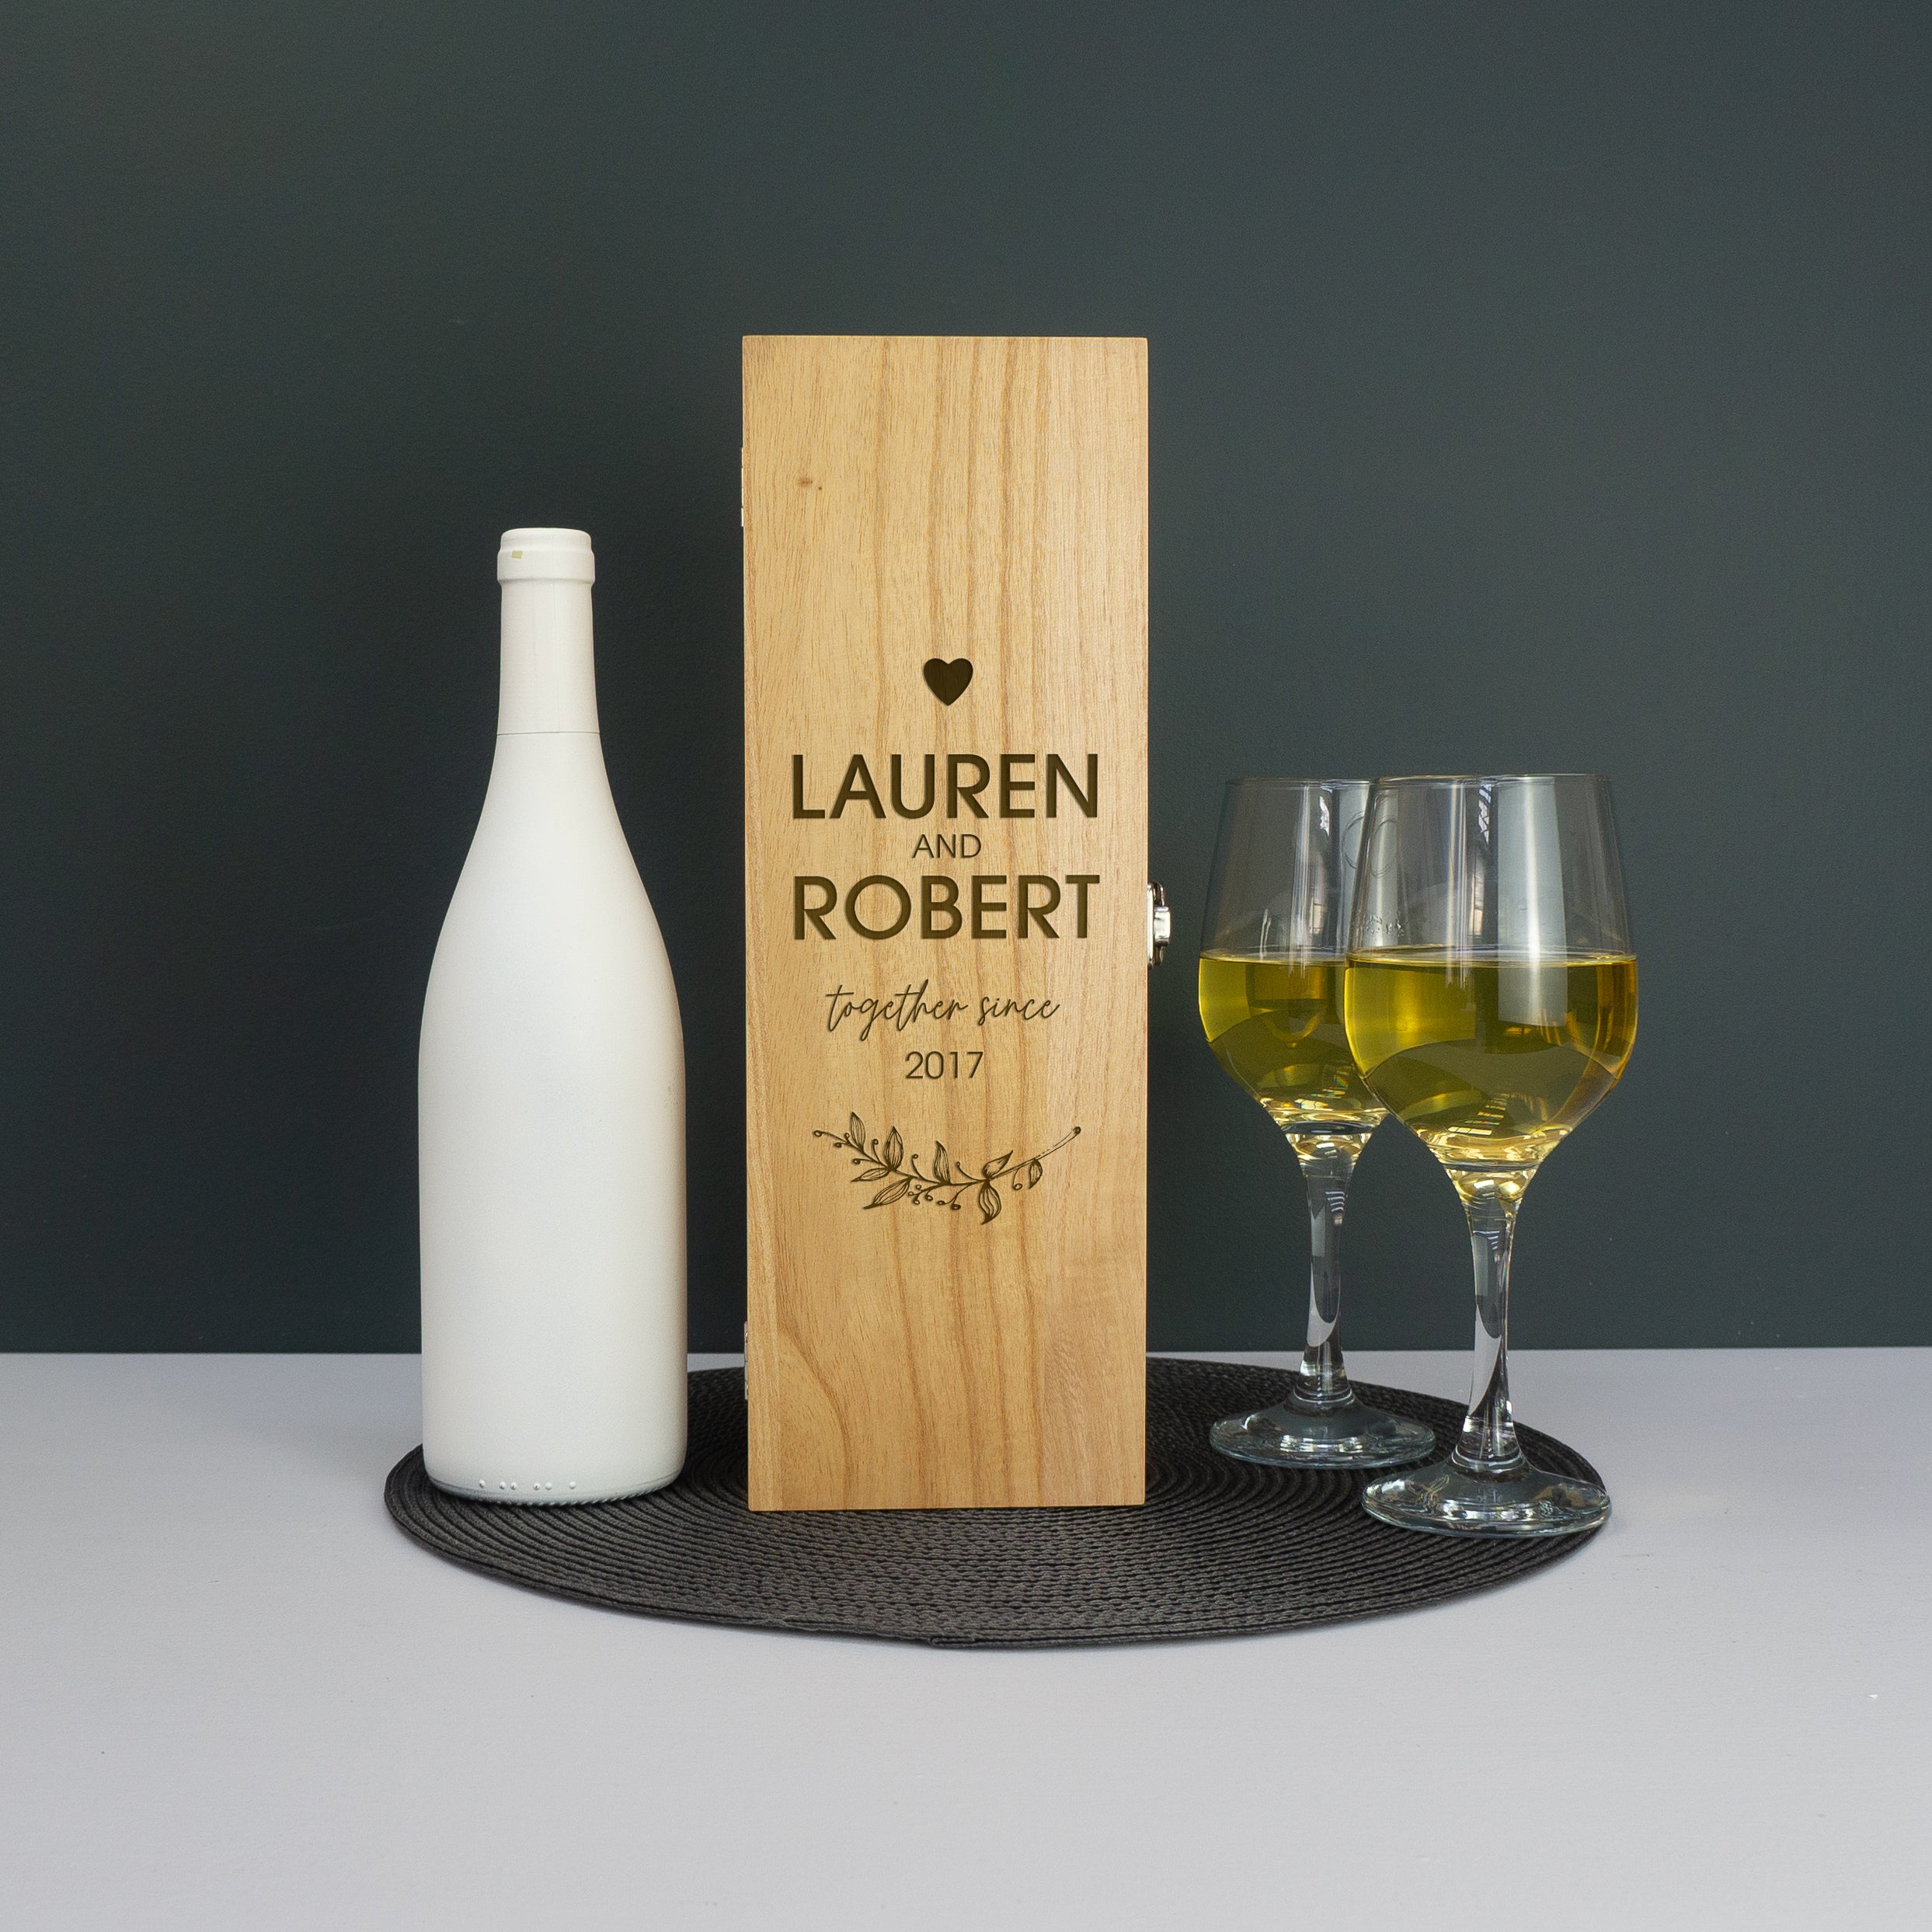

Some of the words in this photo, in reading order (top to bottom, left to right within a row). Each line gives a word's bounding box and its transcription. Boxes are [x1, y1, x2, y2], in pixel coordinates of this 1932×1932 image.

[792, 754, 1098, 820] LAUREN
[911, 834, 982, 858] AND
[792, 874, 1100, 941] ROBERT
[825, 978, 969, 1041] together
[977, 993, 1060, 1025] since
[904, 1050, 983, 1080] 2017
